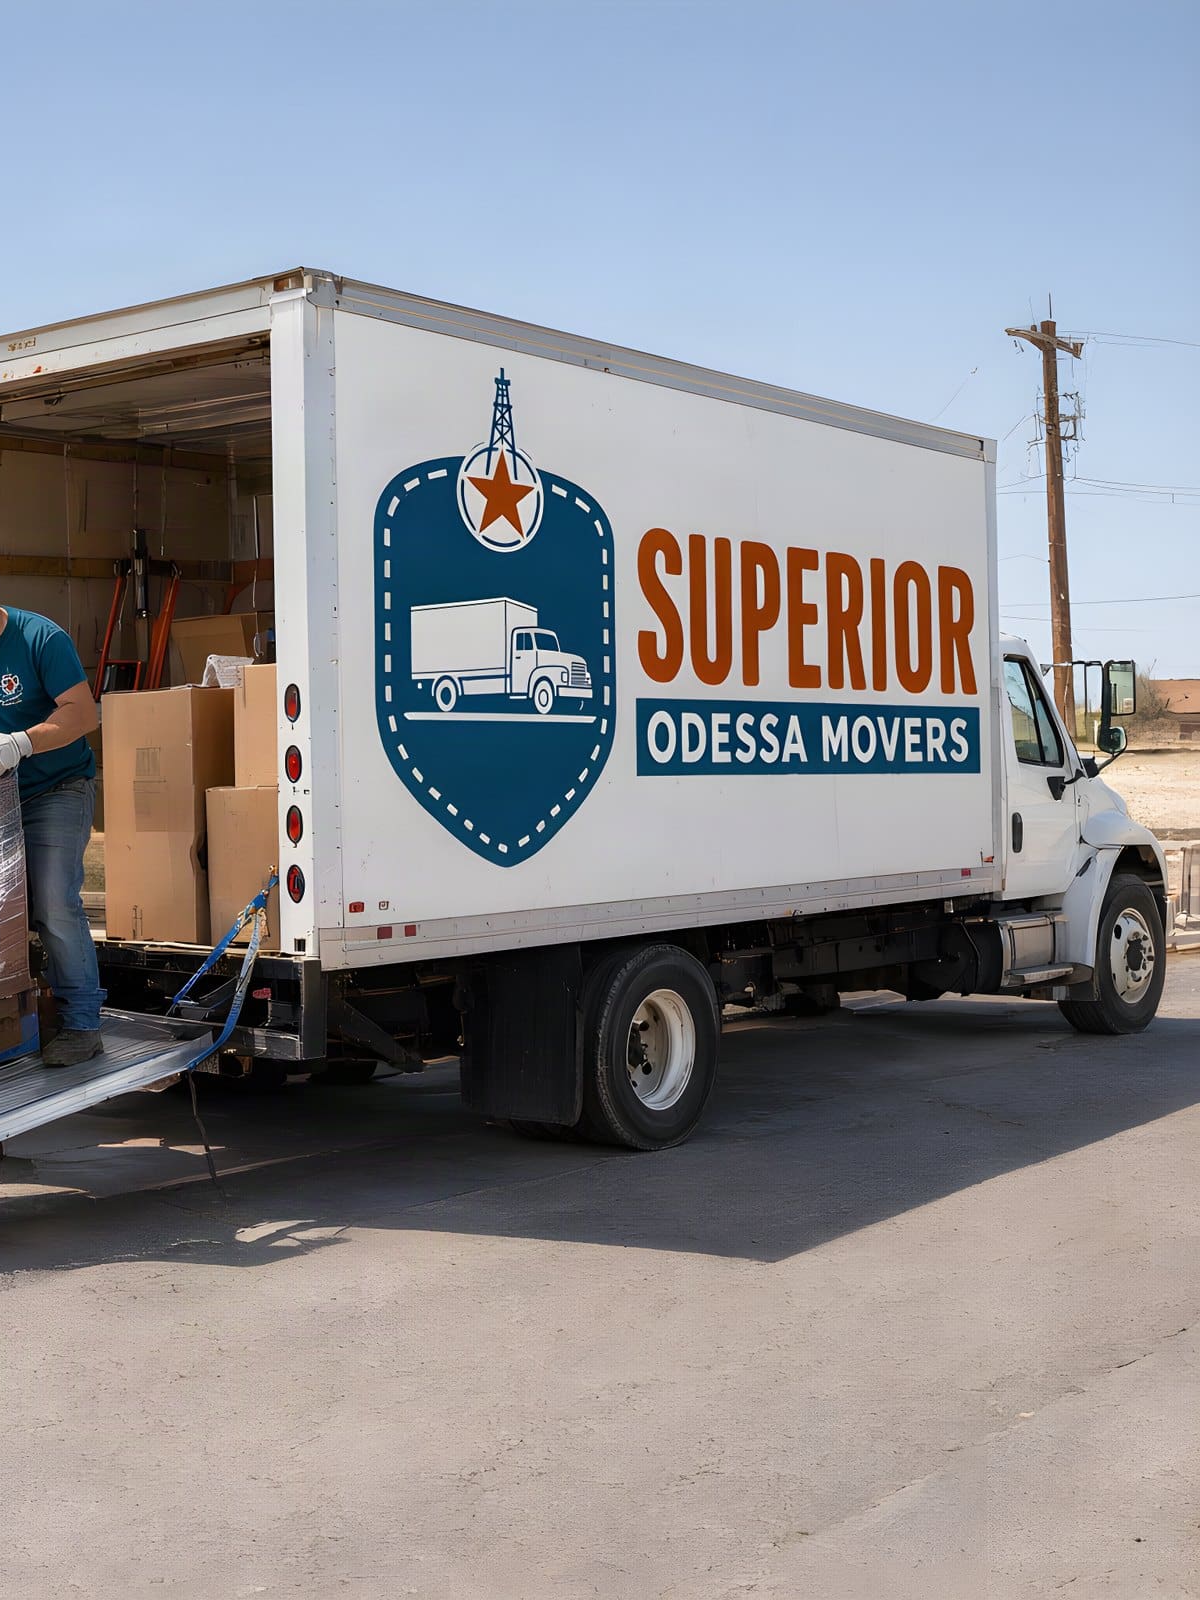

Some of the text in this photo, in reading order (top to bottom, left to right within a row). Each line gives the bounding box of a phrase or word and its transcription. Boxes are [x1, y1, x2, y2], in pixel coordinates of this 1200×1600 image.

[637, 527, 978, 695] SUPERIOR
[647, 710, 969, 764] ODESSA MOVERS
